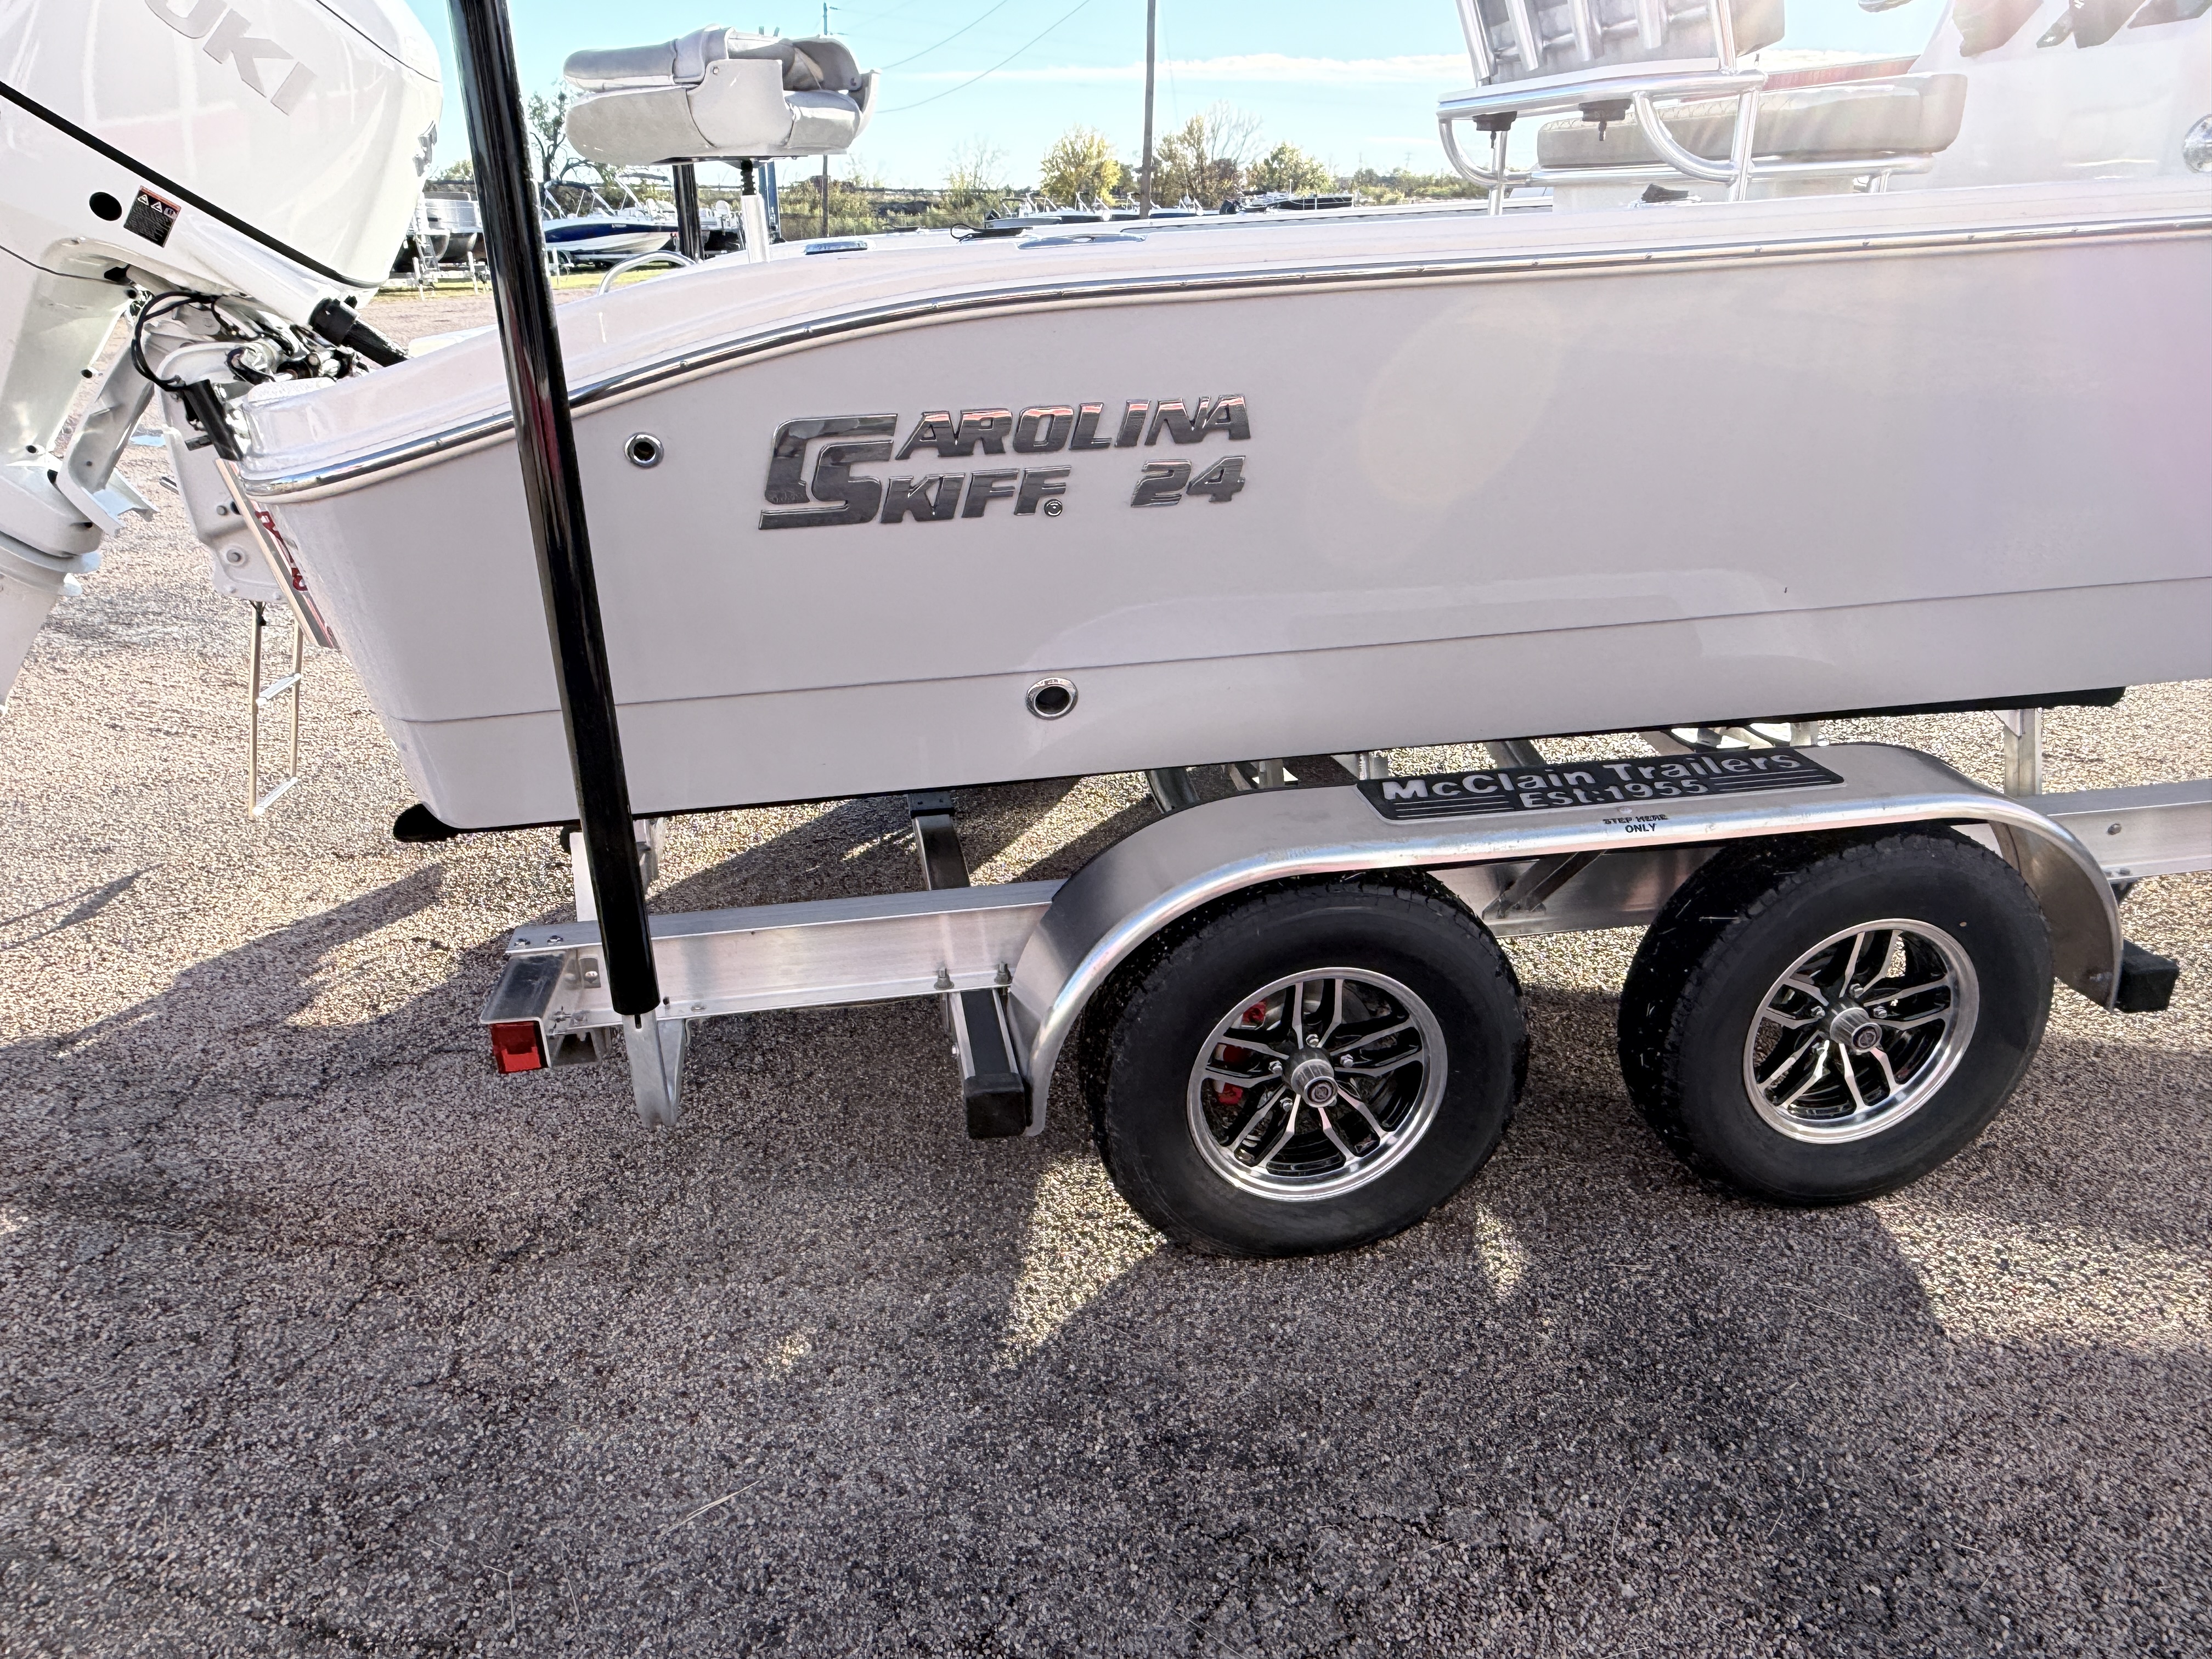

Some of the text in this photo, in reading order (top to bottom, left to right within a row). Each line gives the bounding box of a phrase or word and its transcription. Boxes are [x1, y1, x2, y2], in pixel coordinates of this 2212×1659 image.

[765, 393, 1251, 504] CAROLINA
[1130, 455, 1246, 508] 24
[1382, 754, 1801, 800] McClain Trailers
[1625, 823, 1656, 833] ONLY
